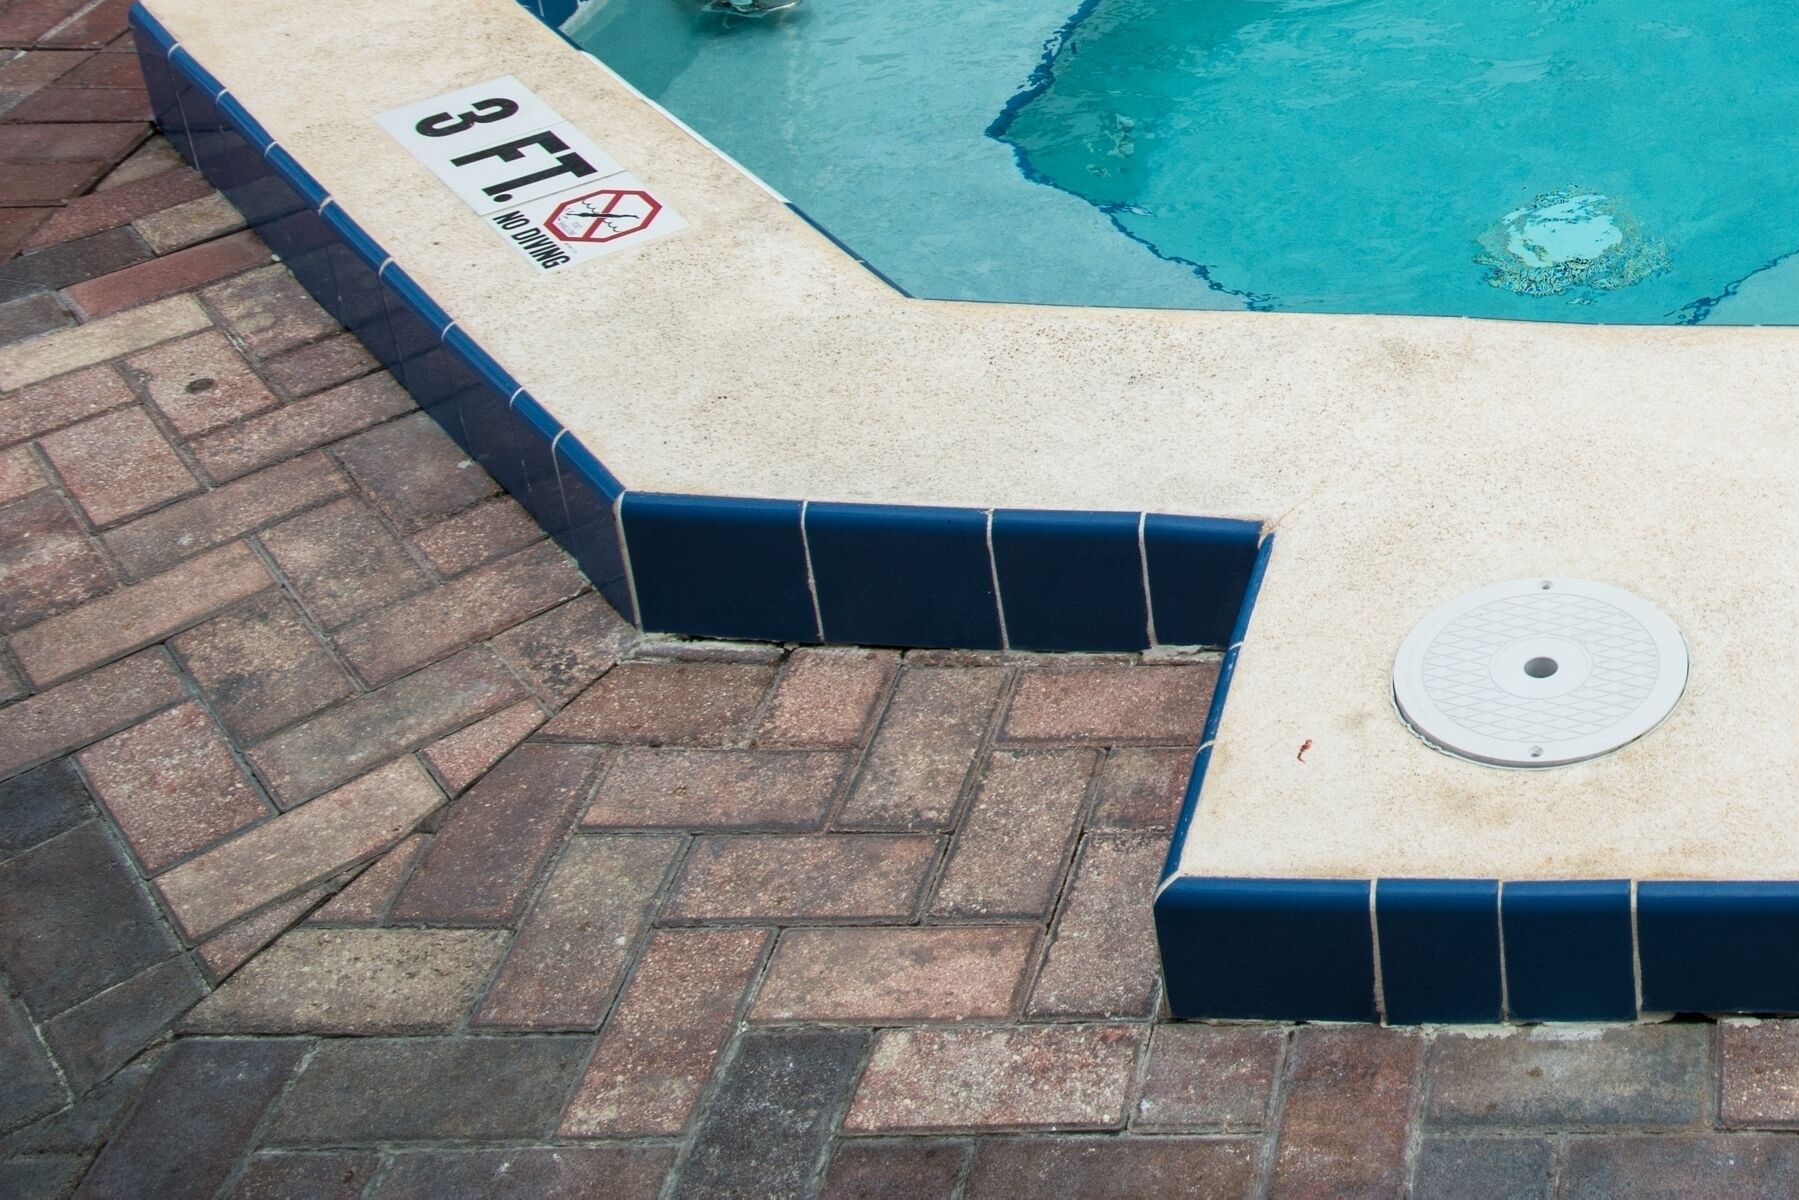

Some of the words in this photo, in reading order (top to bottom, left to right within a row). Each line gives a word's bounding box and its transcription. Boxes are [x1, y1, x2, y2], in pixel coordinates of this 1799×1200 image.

[415, 98, 519, 137] 3
[450, 130, 598, 202] FT.
[492, 210, 531, 230] NO
[511, 227, 571, 270] DIVING
